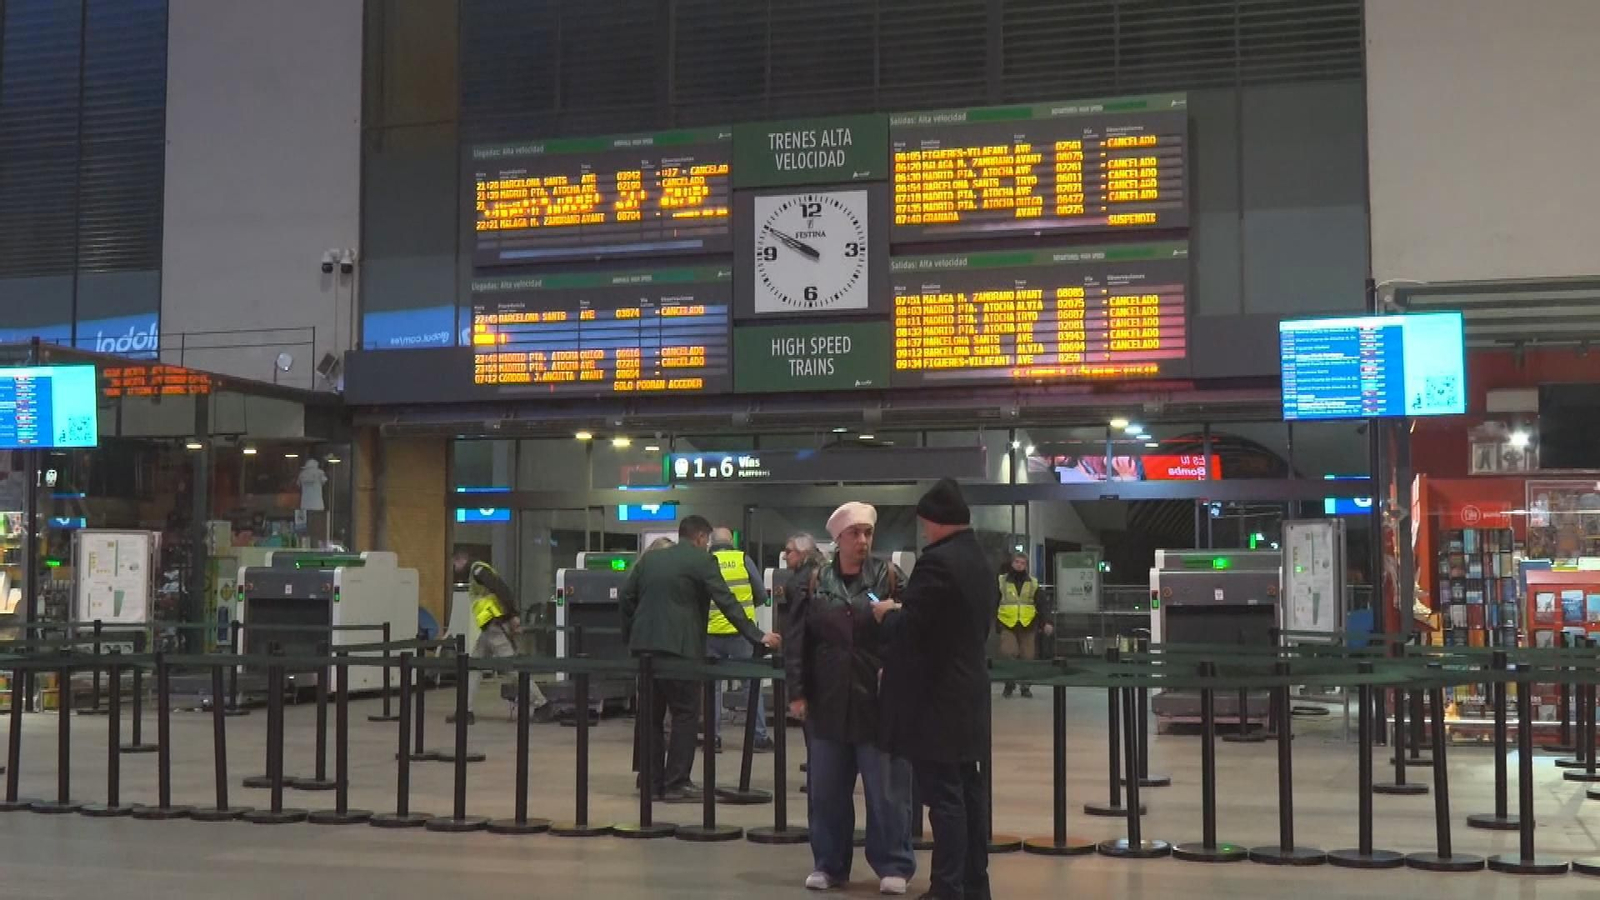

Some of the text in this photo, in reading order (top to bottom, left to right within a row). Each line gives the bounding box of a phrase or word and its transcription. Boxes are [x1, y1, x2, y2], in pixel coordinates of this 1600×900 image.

[767, 127, 852, 150] TRENES ALTA
[1107, 135, 1157, 148] CANCELADO
[775, 149, 845, 170] VELOCIDAD
[1015, 153, 1042, 163] AVANT
[1107, 157, 1157, 169] CANCELADO
[1108, 168, 1157, 179] CANCELADO
[1108, 178, 1157, 190] CANCELADO
[1108, 189, 1158, 201] CANCELADO
[800, 202, 822, 218] 12
[1015, 206, 1042, 217] AVANT
[795, 231, 826, 239] FESTINA
[763, 246, 777, 261] 9
[844, 242, 859, 257] 3
[934, 257, 967, 267] velocidad
[804, 286, 818, 301] 6
[1016, 289, 1043, 299] AVANT
[661, 305, 704, 316] CANCELADO
[923, 304, 954, 314] MADRID
[983, 301, 1015, 312] ATOCHA
[1109, 294, 1159, 306] CANCELADO
[923, 315, 954, 325] MADRID
[983, 312, 1015, 323] ATOCHA
[1109, 306, 1159, 318] CANCELADO
[923, 326, 955, 336] MADRID
[983, 323, 1015, 334] ATOCHA
[1110, 317, 1159, 329] CANCELADO
[973, 335, 1000, 344] SANTS
[1016, 333, 1033, 343] AVE
[1110, 328, 1159, 339] CANCELADO
[661, 346, 704, 357] CANCELADO
[771, 336, 851, 356] HIGH SPEED
[923, 347, 970, 358] BARCELONA
[973, 345, 1001, 355] SANTS
[1110, 339, 1159, 350] CANCELADO
[661, 356, 705, 367] CANCELADO
[788, 358, 835, 376] TRAINS
[923, 355, 1010, 368] FIGUERES-VILAFANT
[1017, 355, 1034, 364] AVE
[693, 458, 706, 477] 1
[720, 456, 734, 477] 6
